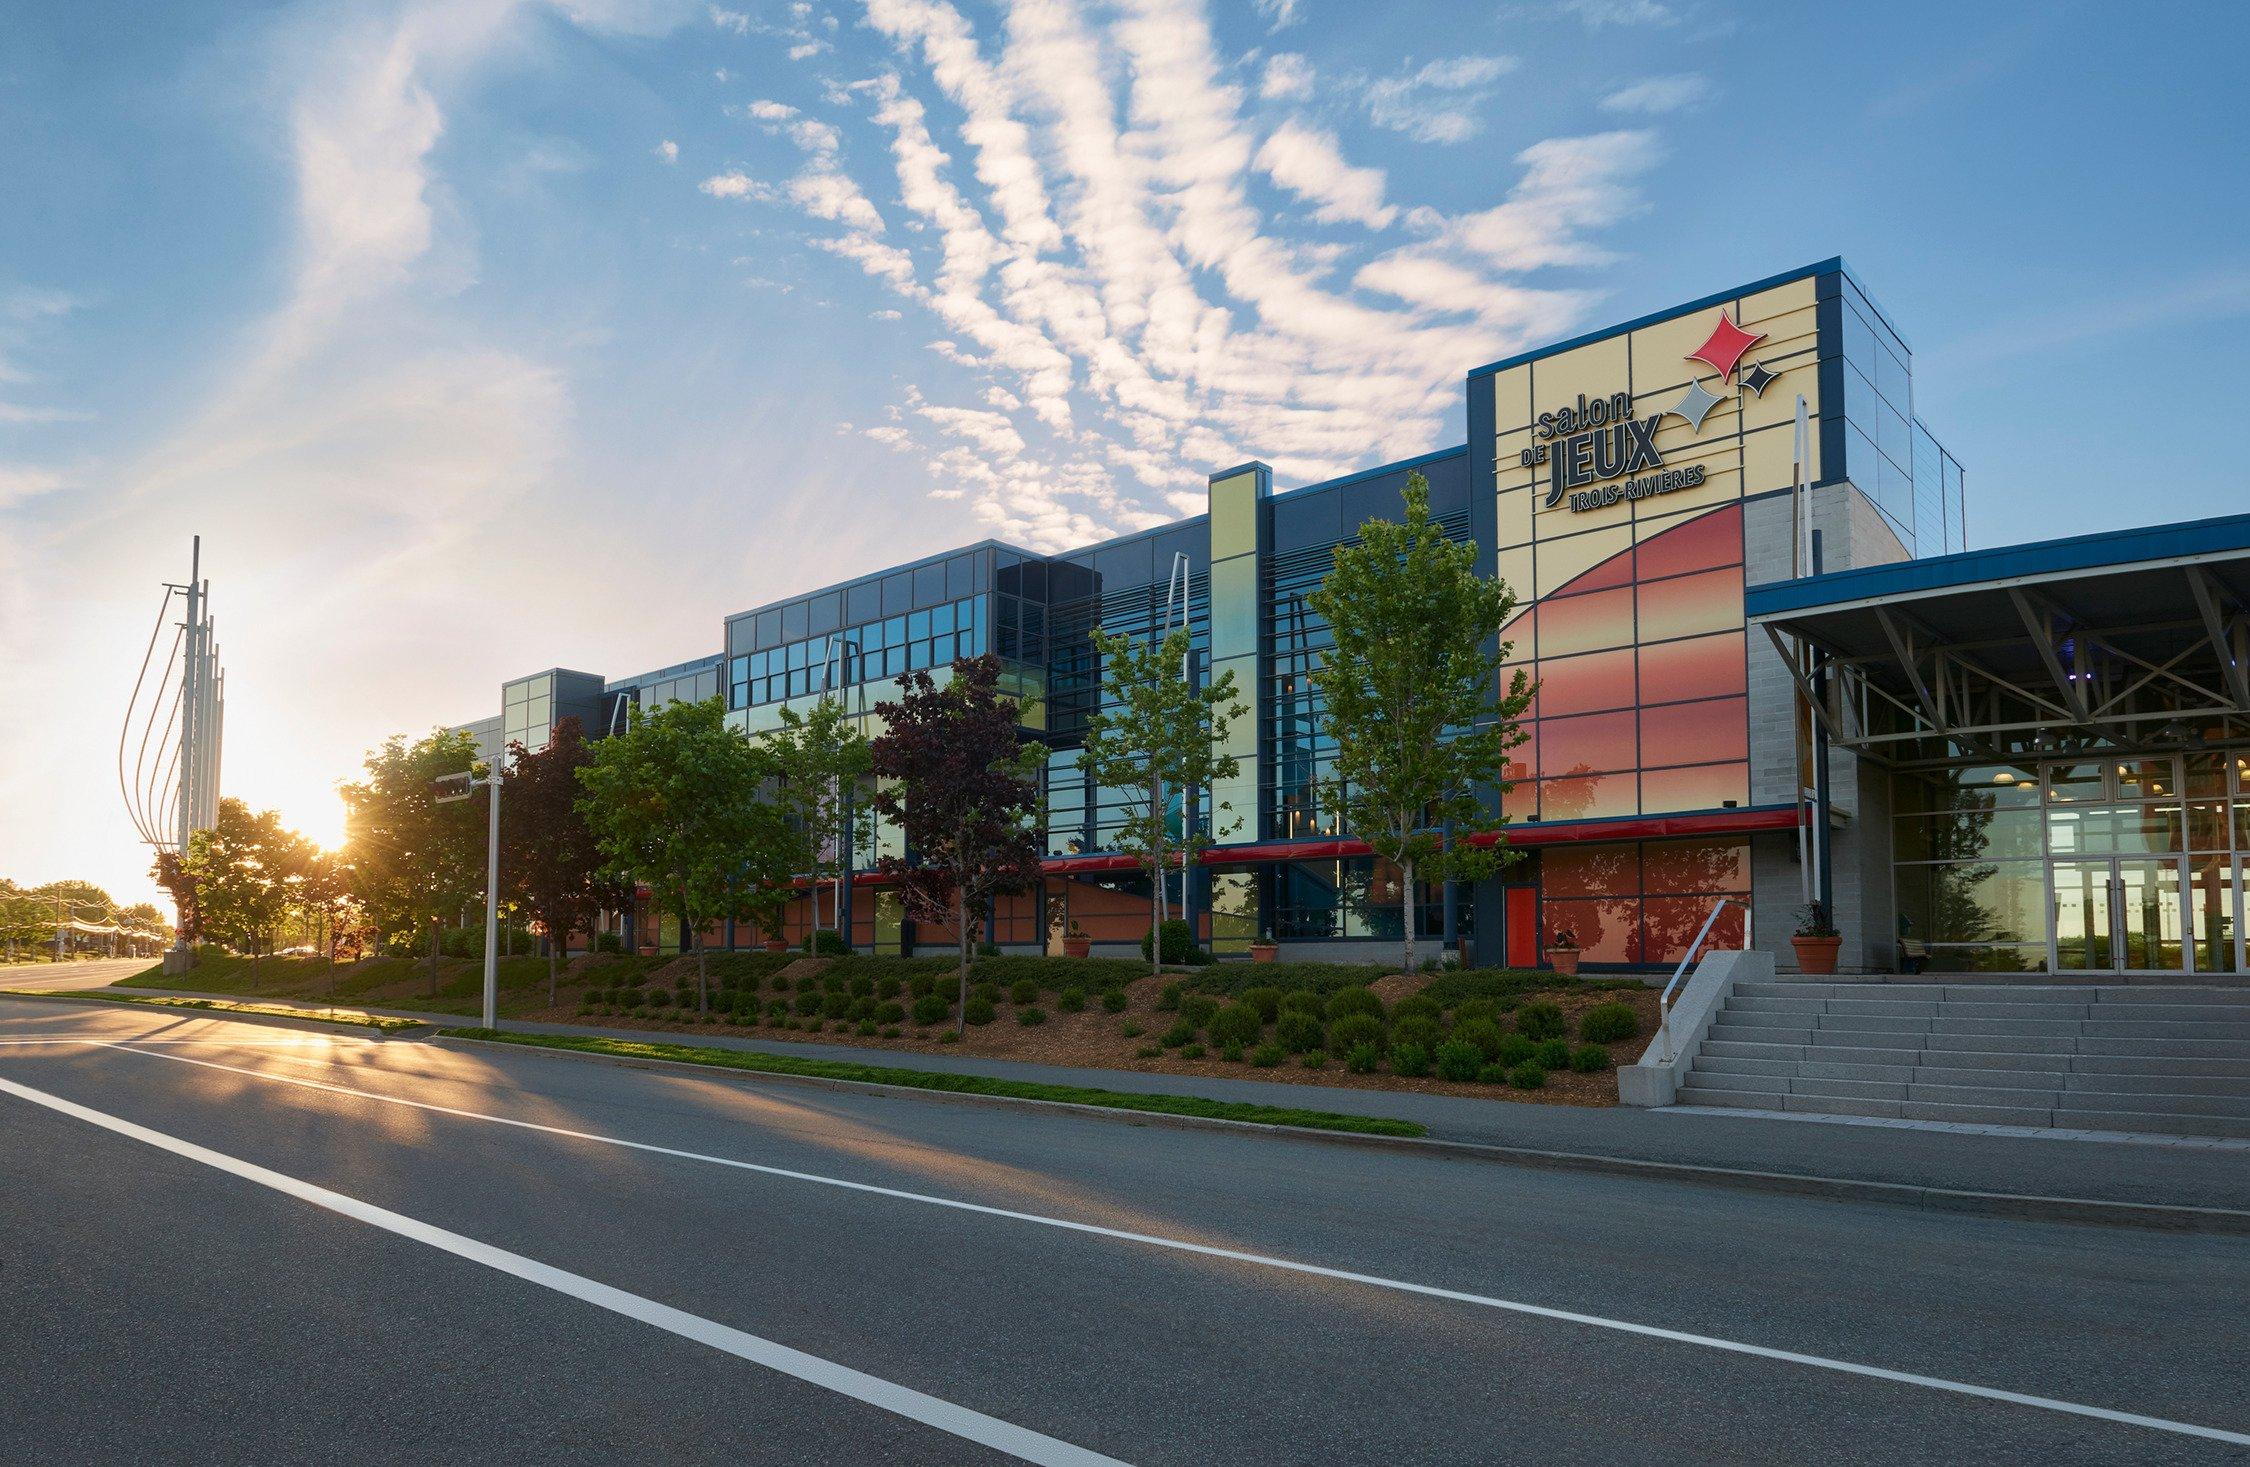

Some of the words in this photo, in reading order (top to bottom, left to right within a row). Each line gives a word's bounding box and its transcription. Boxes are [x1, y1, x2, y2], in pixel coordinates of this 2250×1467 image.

[1538, 392, 1633, 438] salon
[1521, 444, 1545, 467] DE
[1545, 413, 1663, 508] JEUX
[1569, 465, 1706, 512] TROIS-RIVIÈRES
